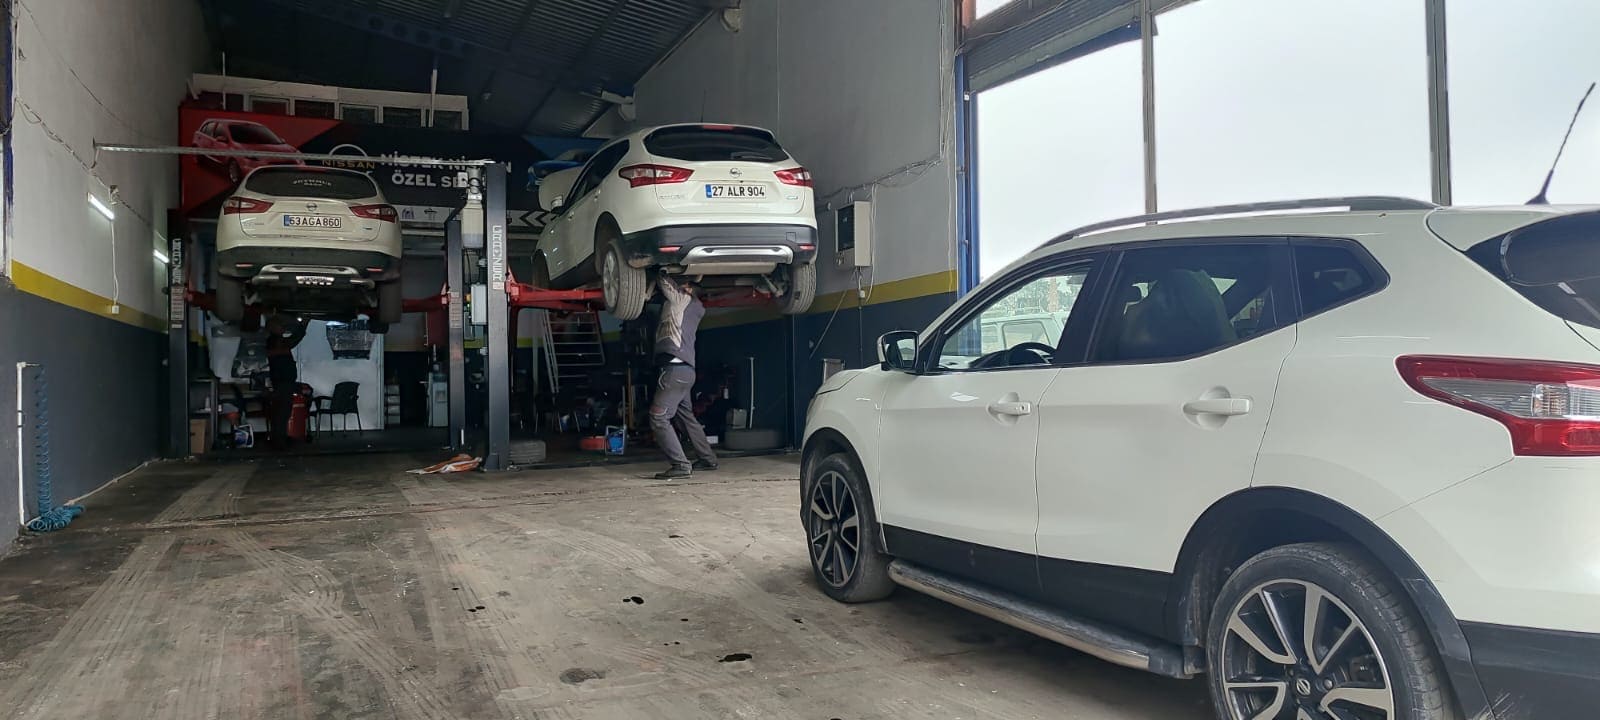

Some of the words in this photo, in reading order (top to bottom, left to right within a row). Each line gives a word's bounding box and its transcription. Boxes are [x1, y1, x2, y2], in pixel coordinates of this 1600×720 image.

[322, 160, 375, 169] NISSAN
[392, 169, 437, 187] ÖZEL
[712, 186, 724, 196] 27
[728, 186, 746, 197] ALR
[747, 186, 765, 197] 904
